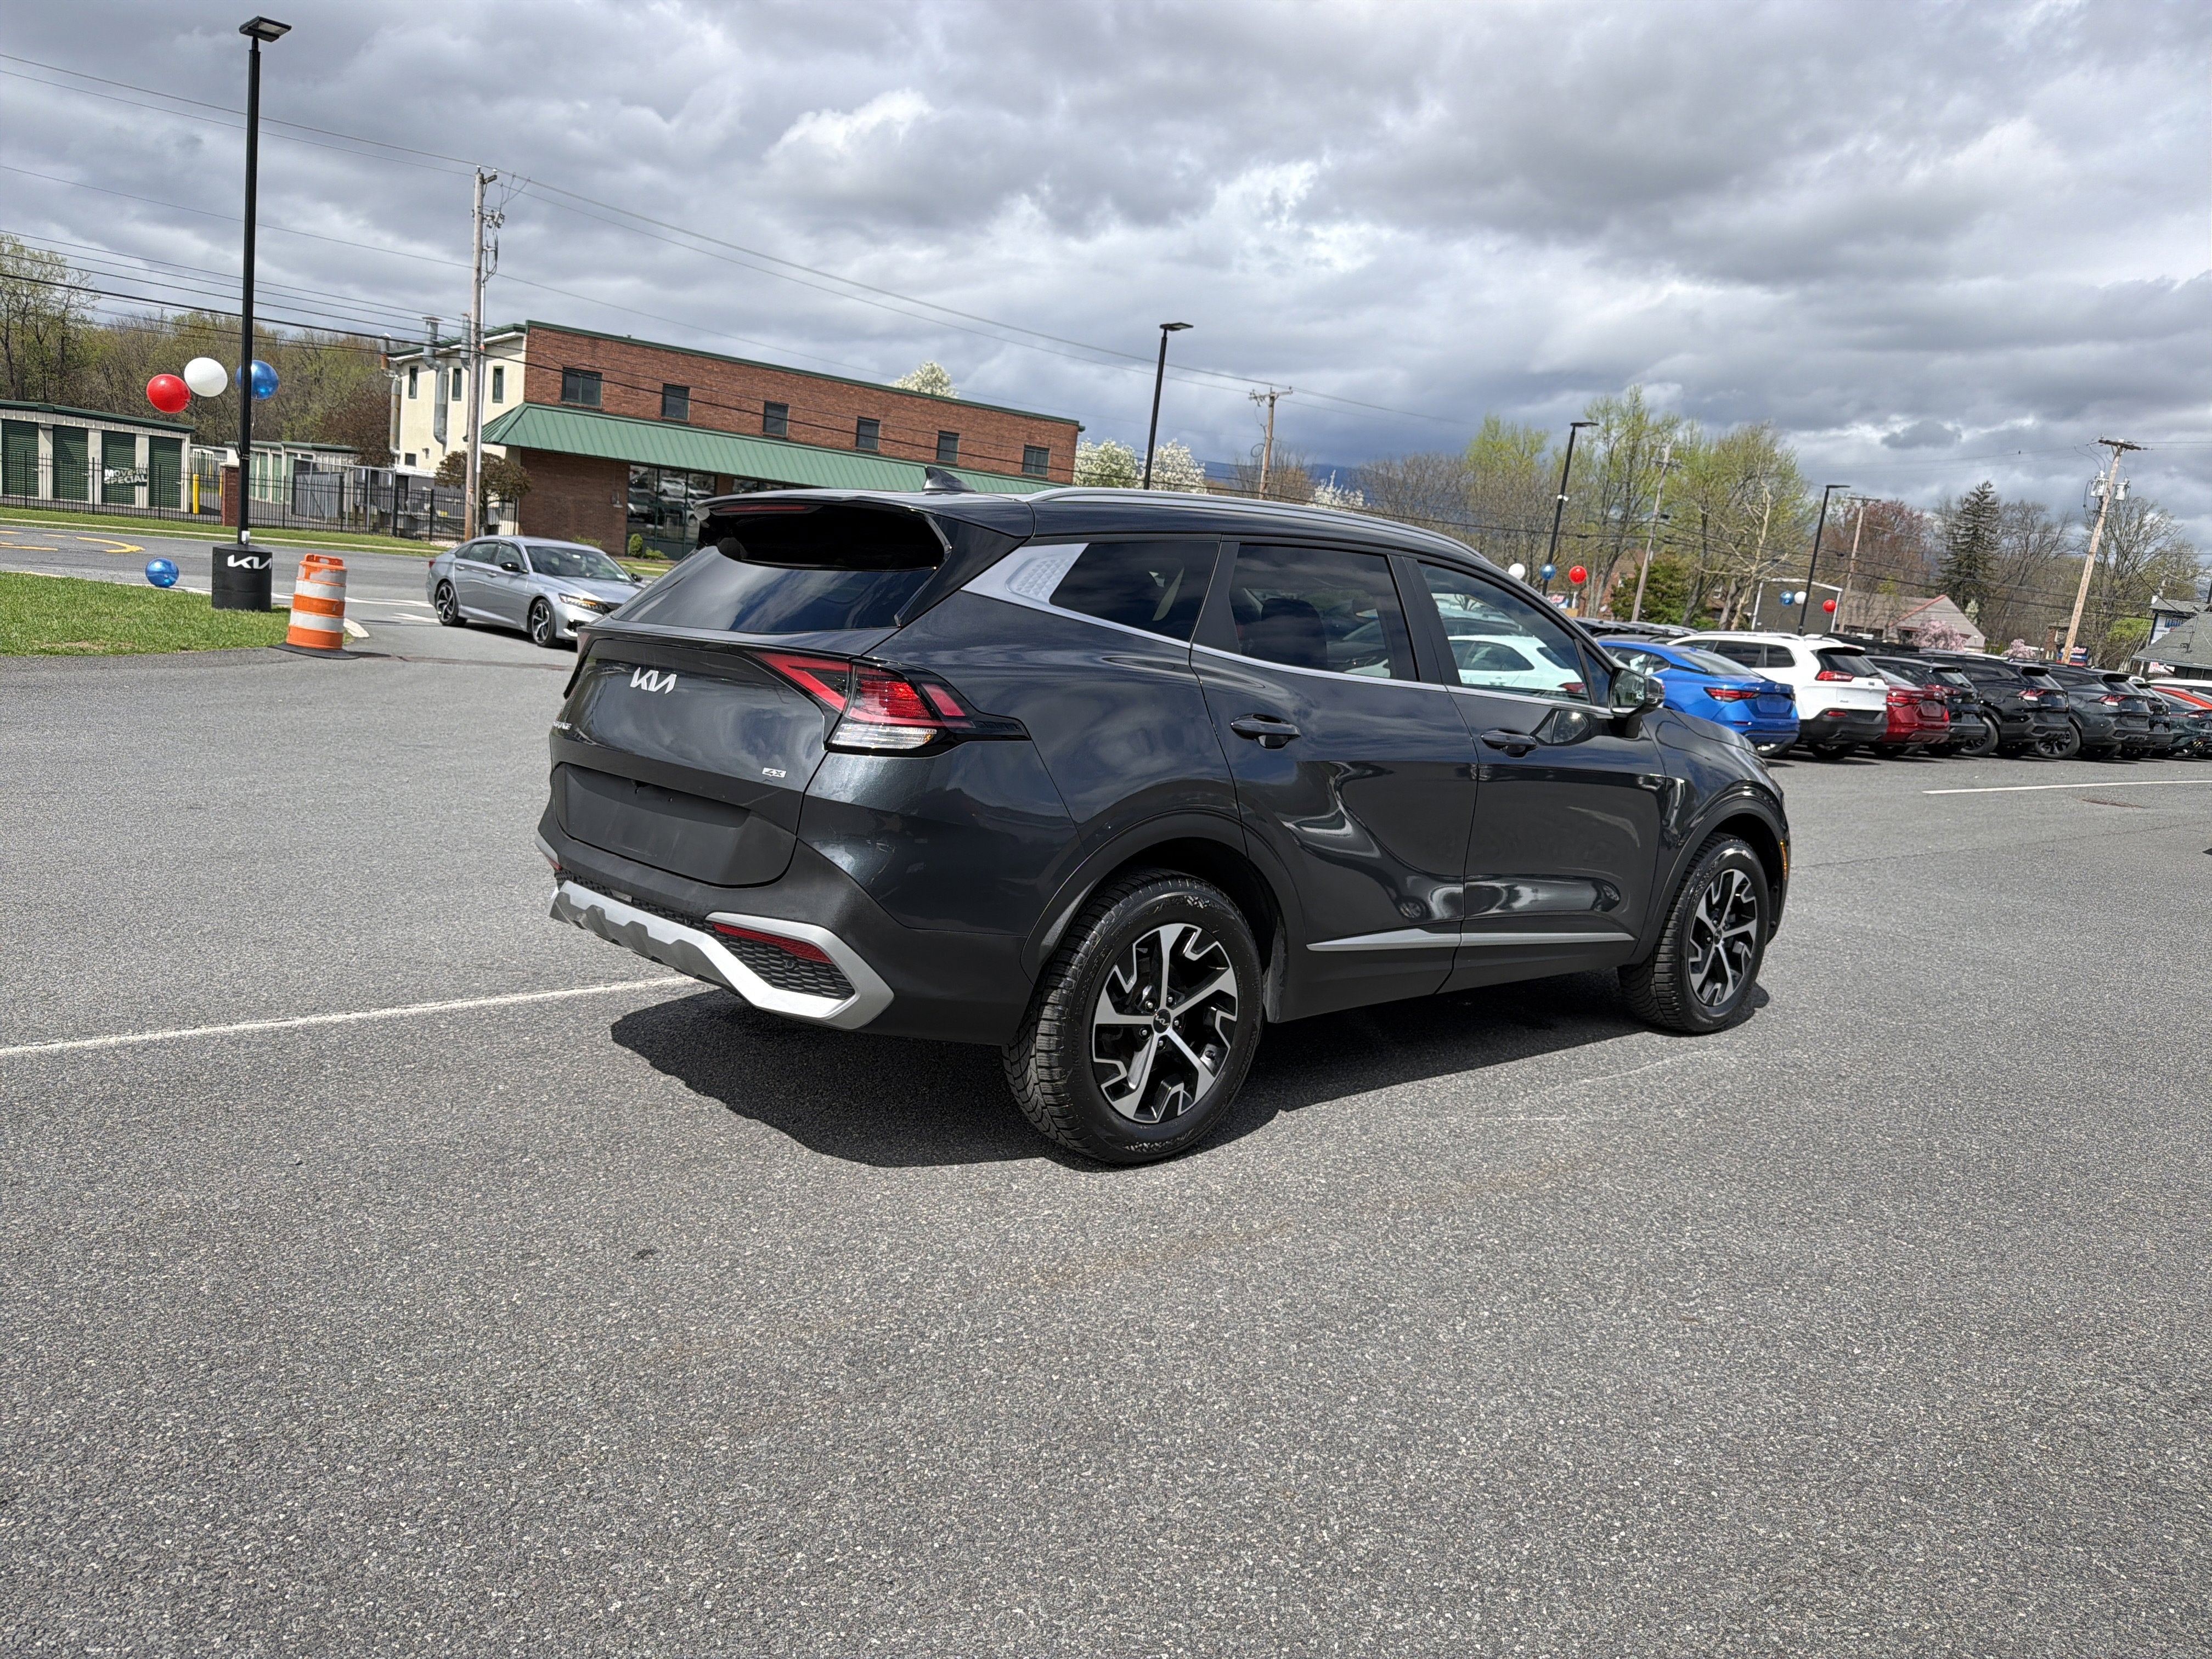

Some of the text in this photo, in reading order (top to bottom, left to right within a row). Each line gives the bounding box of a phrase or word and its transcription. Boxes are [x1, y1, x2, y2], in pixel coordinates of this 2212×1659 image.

[104, 469, 147, 477] MOVE-IN
[104, 475, 148, 484] SPECIAL
[227, 555, 272, 569] KIA
[630, 667, 678, 695] KIA
